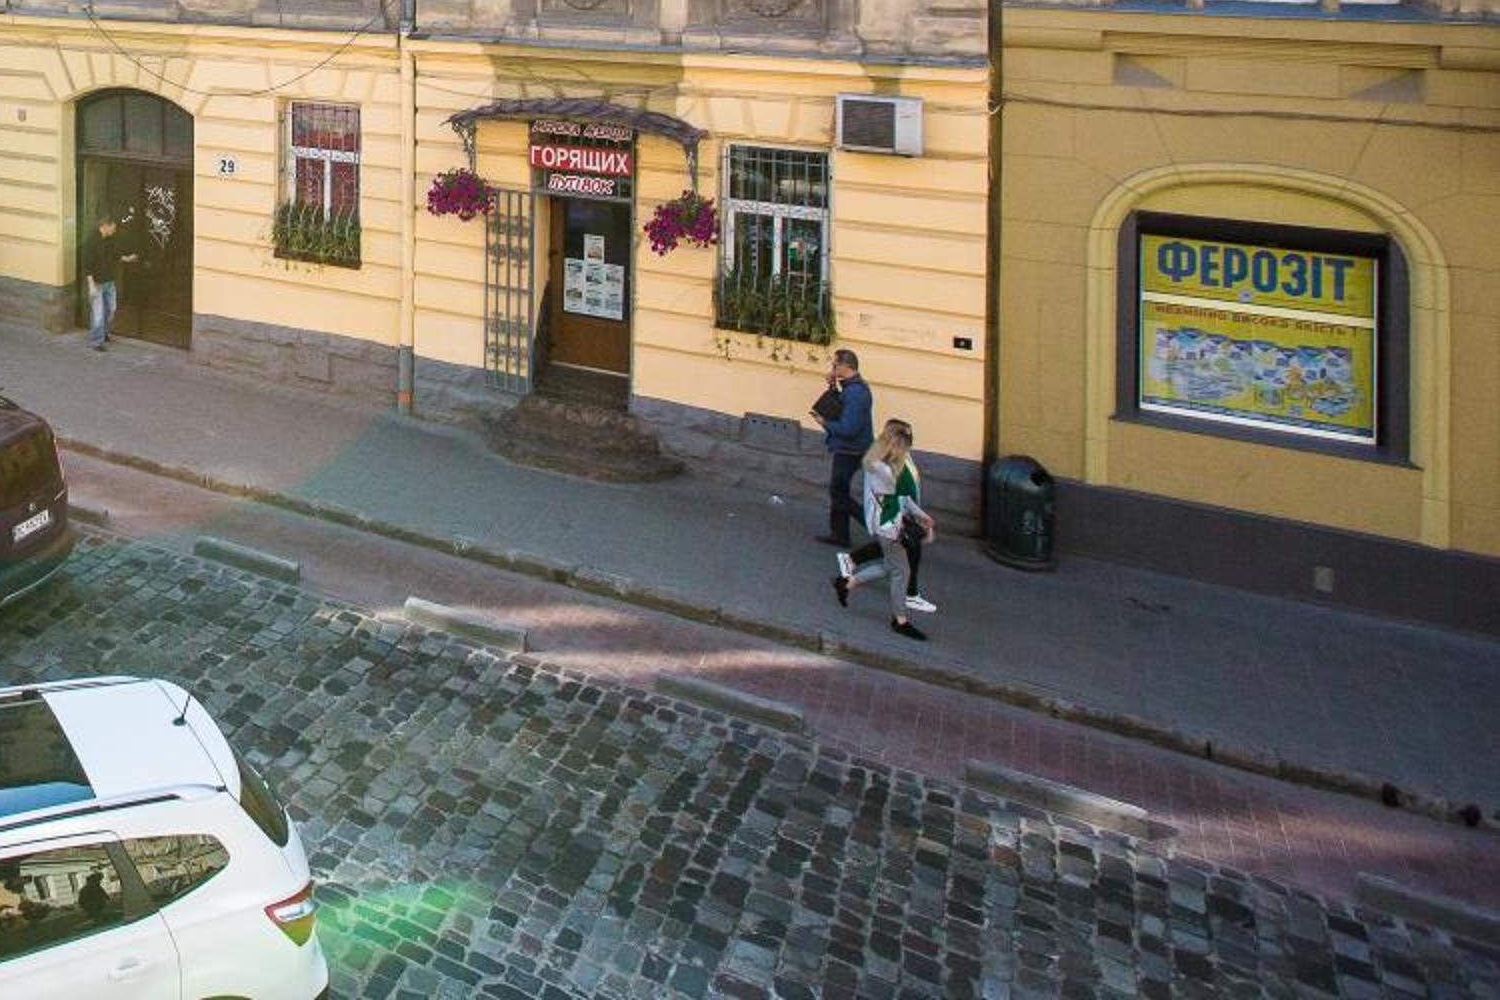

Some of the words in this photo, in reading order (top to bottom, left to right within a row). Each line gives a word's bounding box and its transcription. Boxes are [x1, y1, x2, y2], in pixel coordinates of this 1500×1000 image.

[220, 159, 235, 173] 29
[530, 145, 630, 175] ГОРЯЩИХ
[1157, 241, 1355, 302] ФЕРОЗІТ
